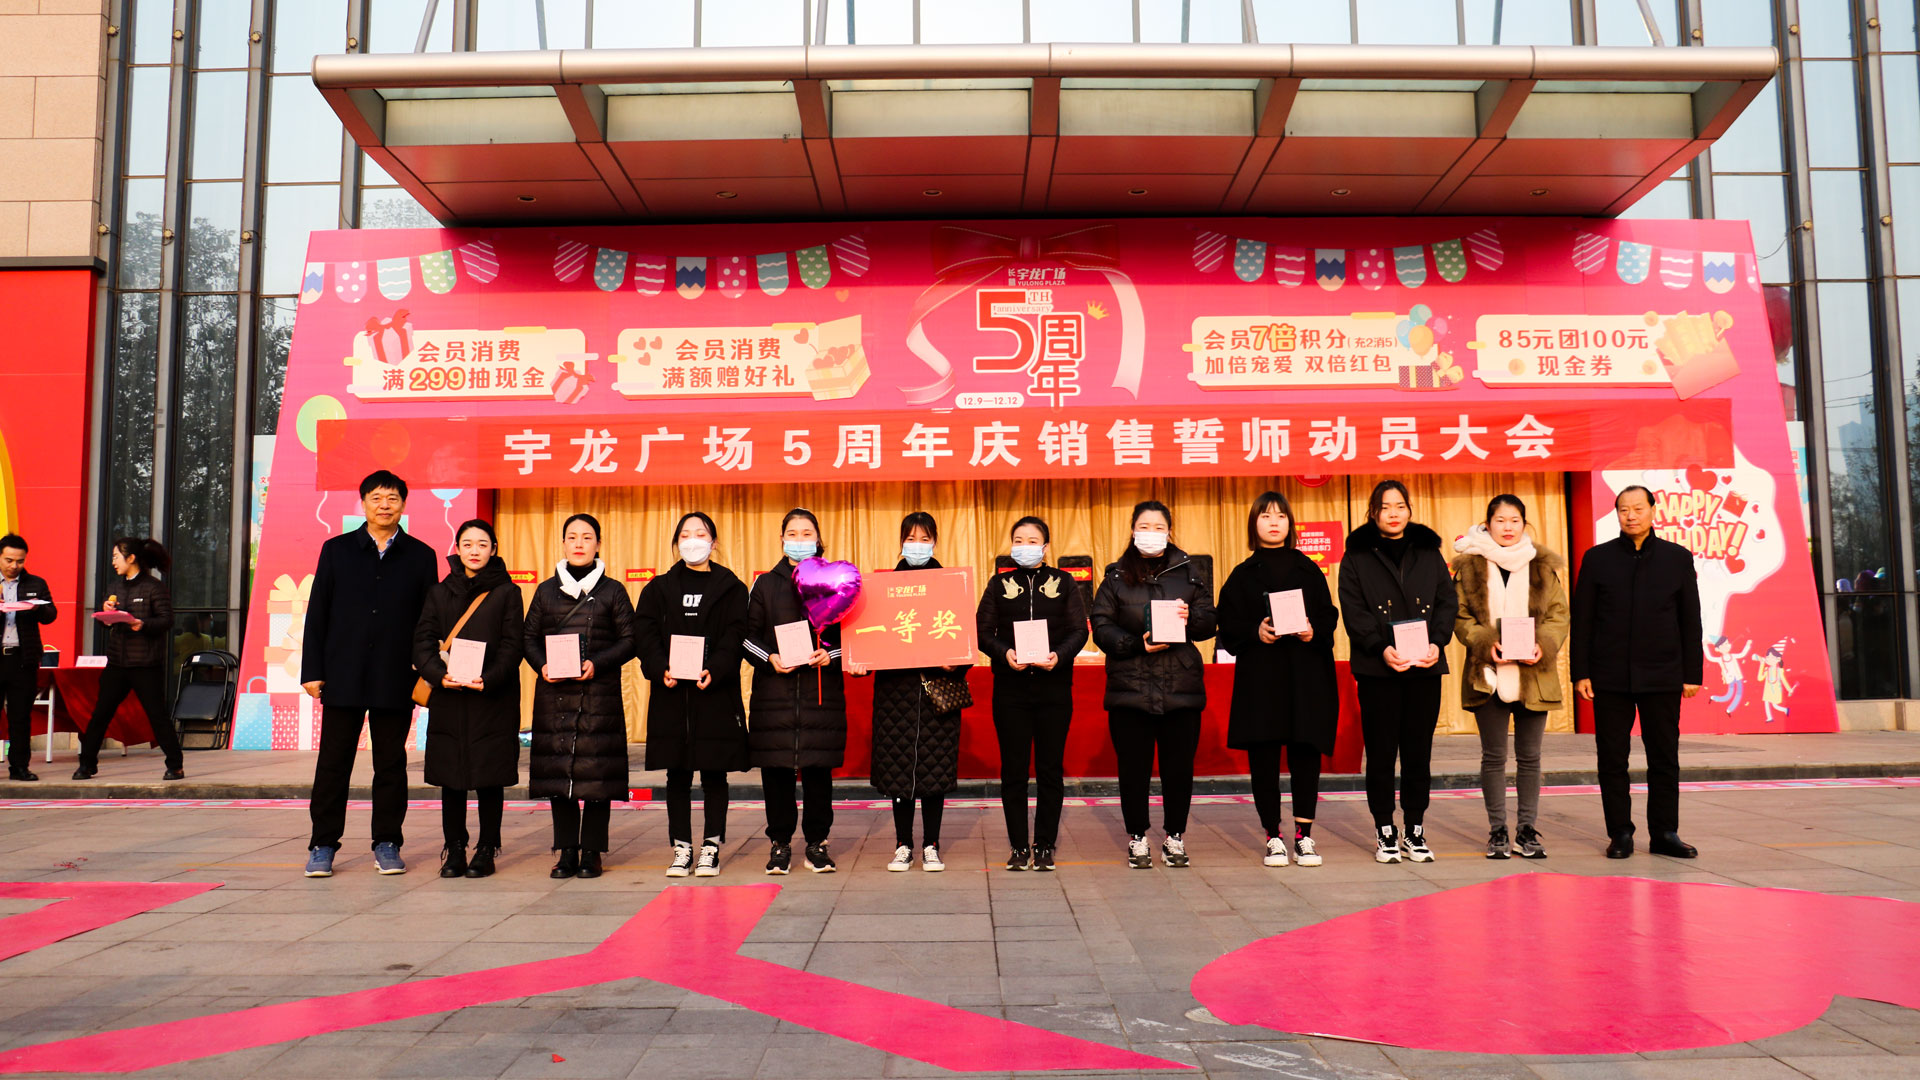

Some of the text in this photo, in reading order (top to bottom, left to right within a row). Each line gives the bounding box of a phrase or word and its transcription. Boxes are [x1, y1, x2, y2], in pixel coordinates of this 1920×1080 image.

[1017, 268, 1066, 280] 宇龙广场
[418, 339, 520, 363] 会员消费
[675, 337, 781, 361] 会员消费
[1204, 353, 1392, 375] 加倍宠爱 双倍红包
[1537, 355, 1613, 377] 现金券
[382, 366, 545, 391] 满299抽现金
[662, 364, 795, 389] 满额赠好礼
[503, 414, 1555, 476] 宇龙广场5周年庆销售誓师动员大会
[1655, 489, 1722, 525] HAPPY
[855, 608, 963, 644] 一等奖
